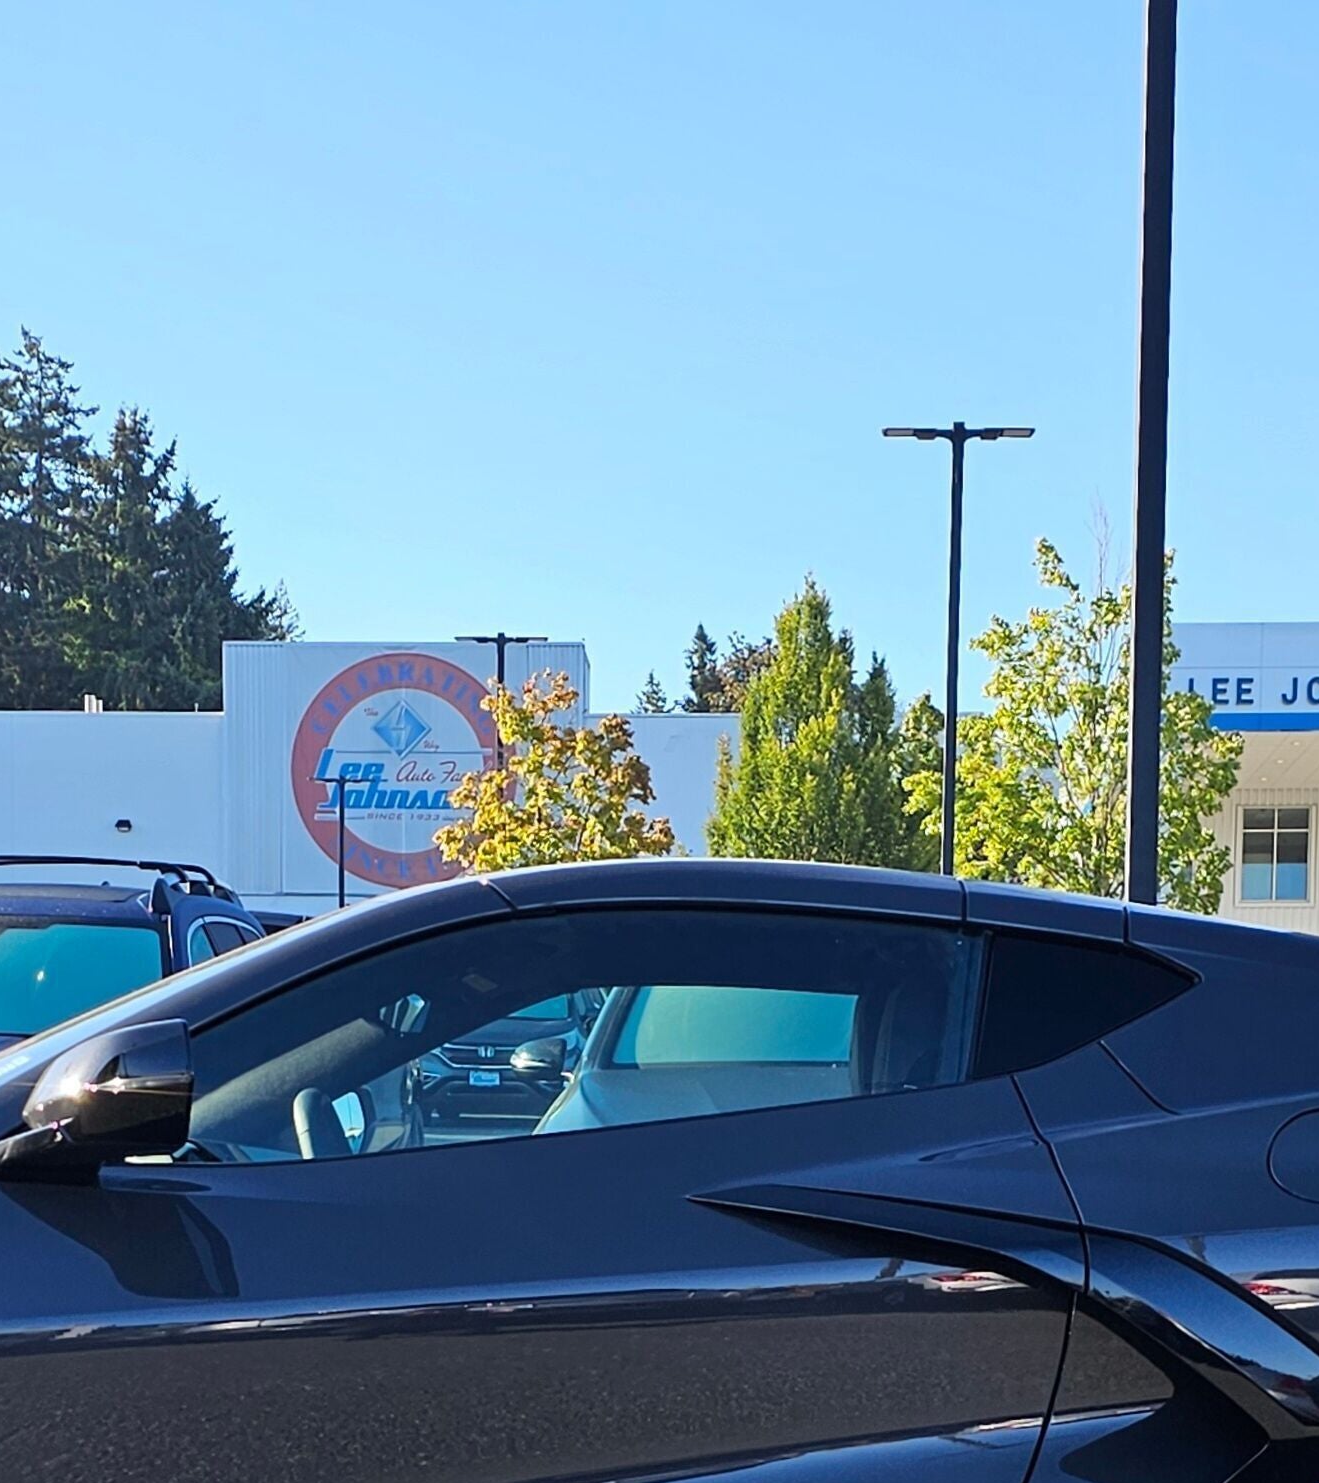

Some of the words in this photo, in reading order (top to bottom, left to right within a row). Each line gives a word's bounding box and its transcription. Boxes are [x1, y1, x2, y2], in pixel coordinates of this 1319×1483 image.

[315, 749, 385, 782] Lee
[396, 760, 436, 782] Auto
[316, 776, 472, 810] Johnso
